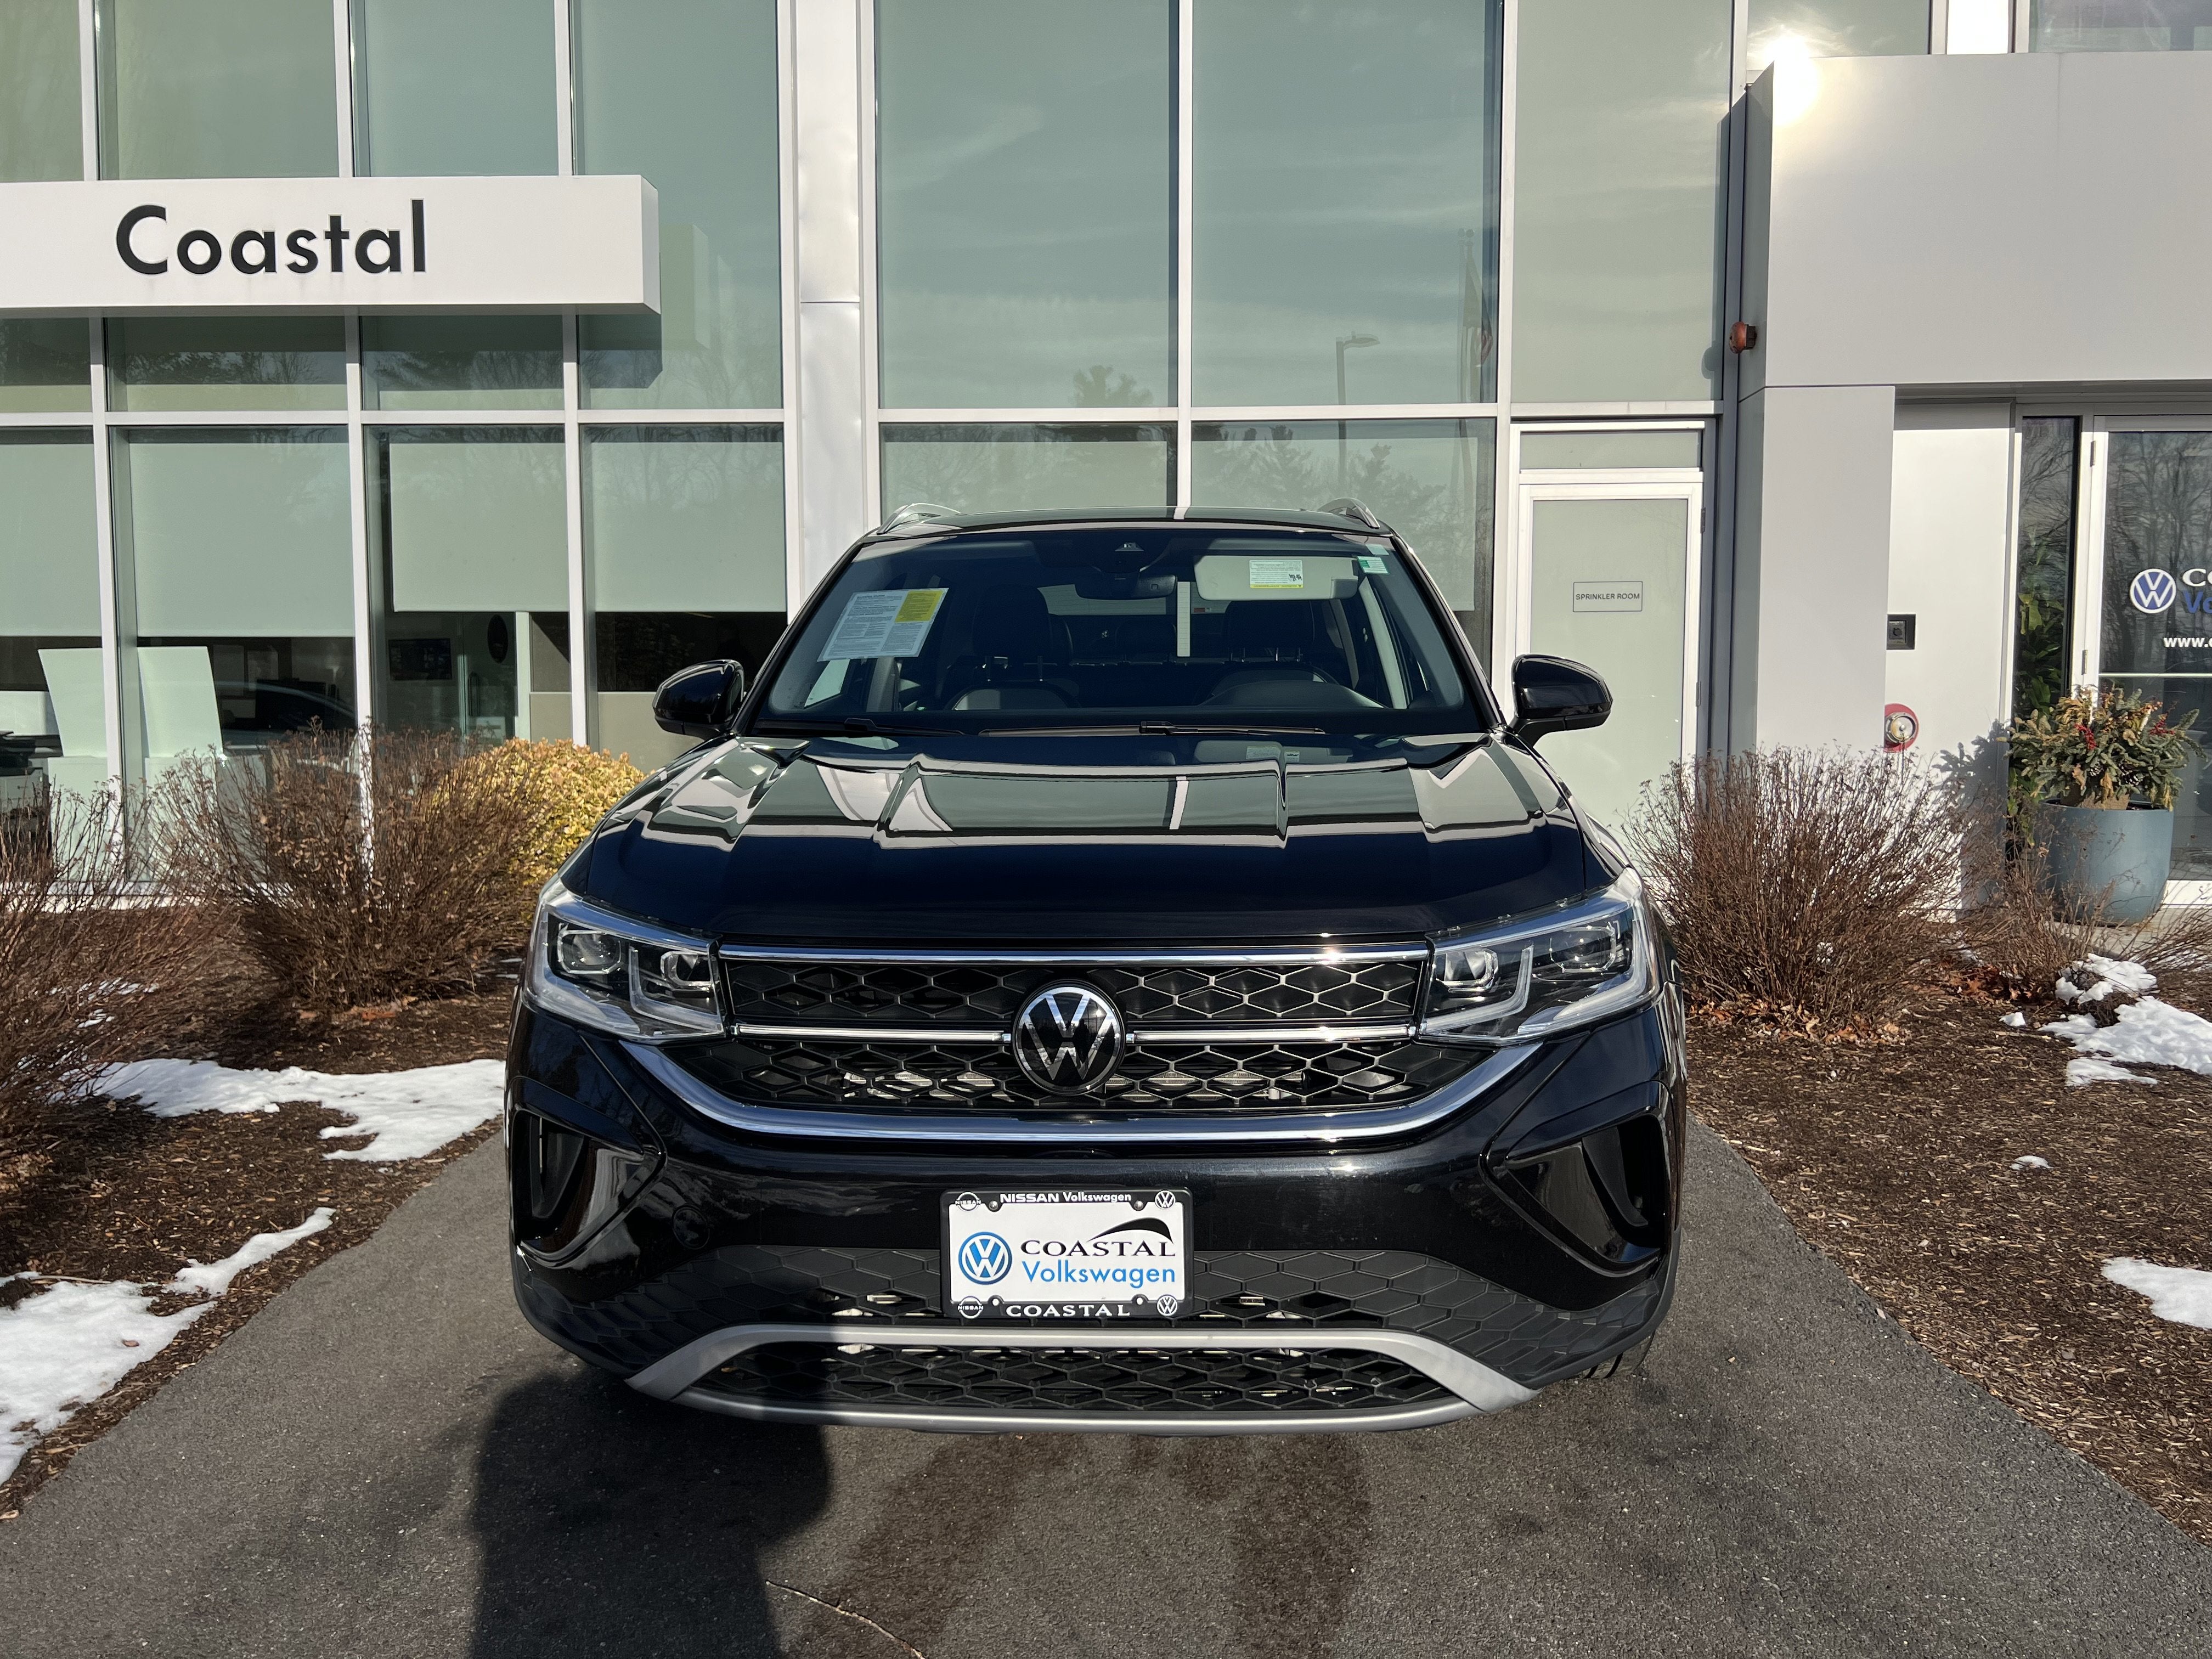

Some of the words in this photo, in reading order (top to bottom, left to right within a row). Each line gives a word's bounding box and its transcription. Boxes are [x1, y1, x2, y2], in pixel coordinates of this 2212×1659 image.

[116, 199, 425, 275] Coastal
[2182, 568, 2212, 586] C
[1000, 1193, 1059, 1203] NISSAN
[1063, 1191, 1131, 1203] Volkswagen
[1020, 1240, 1176, 1256] COASTAL
[1022, 1260, 1175, 1288] Volkswagen
[1006, 1304, 1130, 1317] COASTAL
